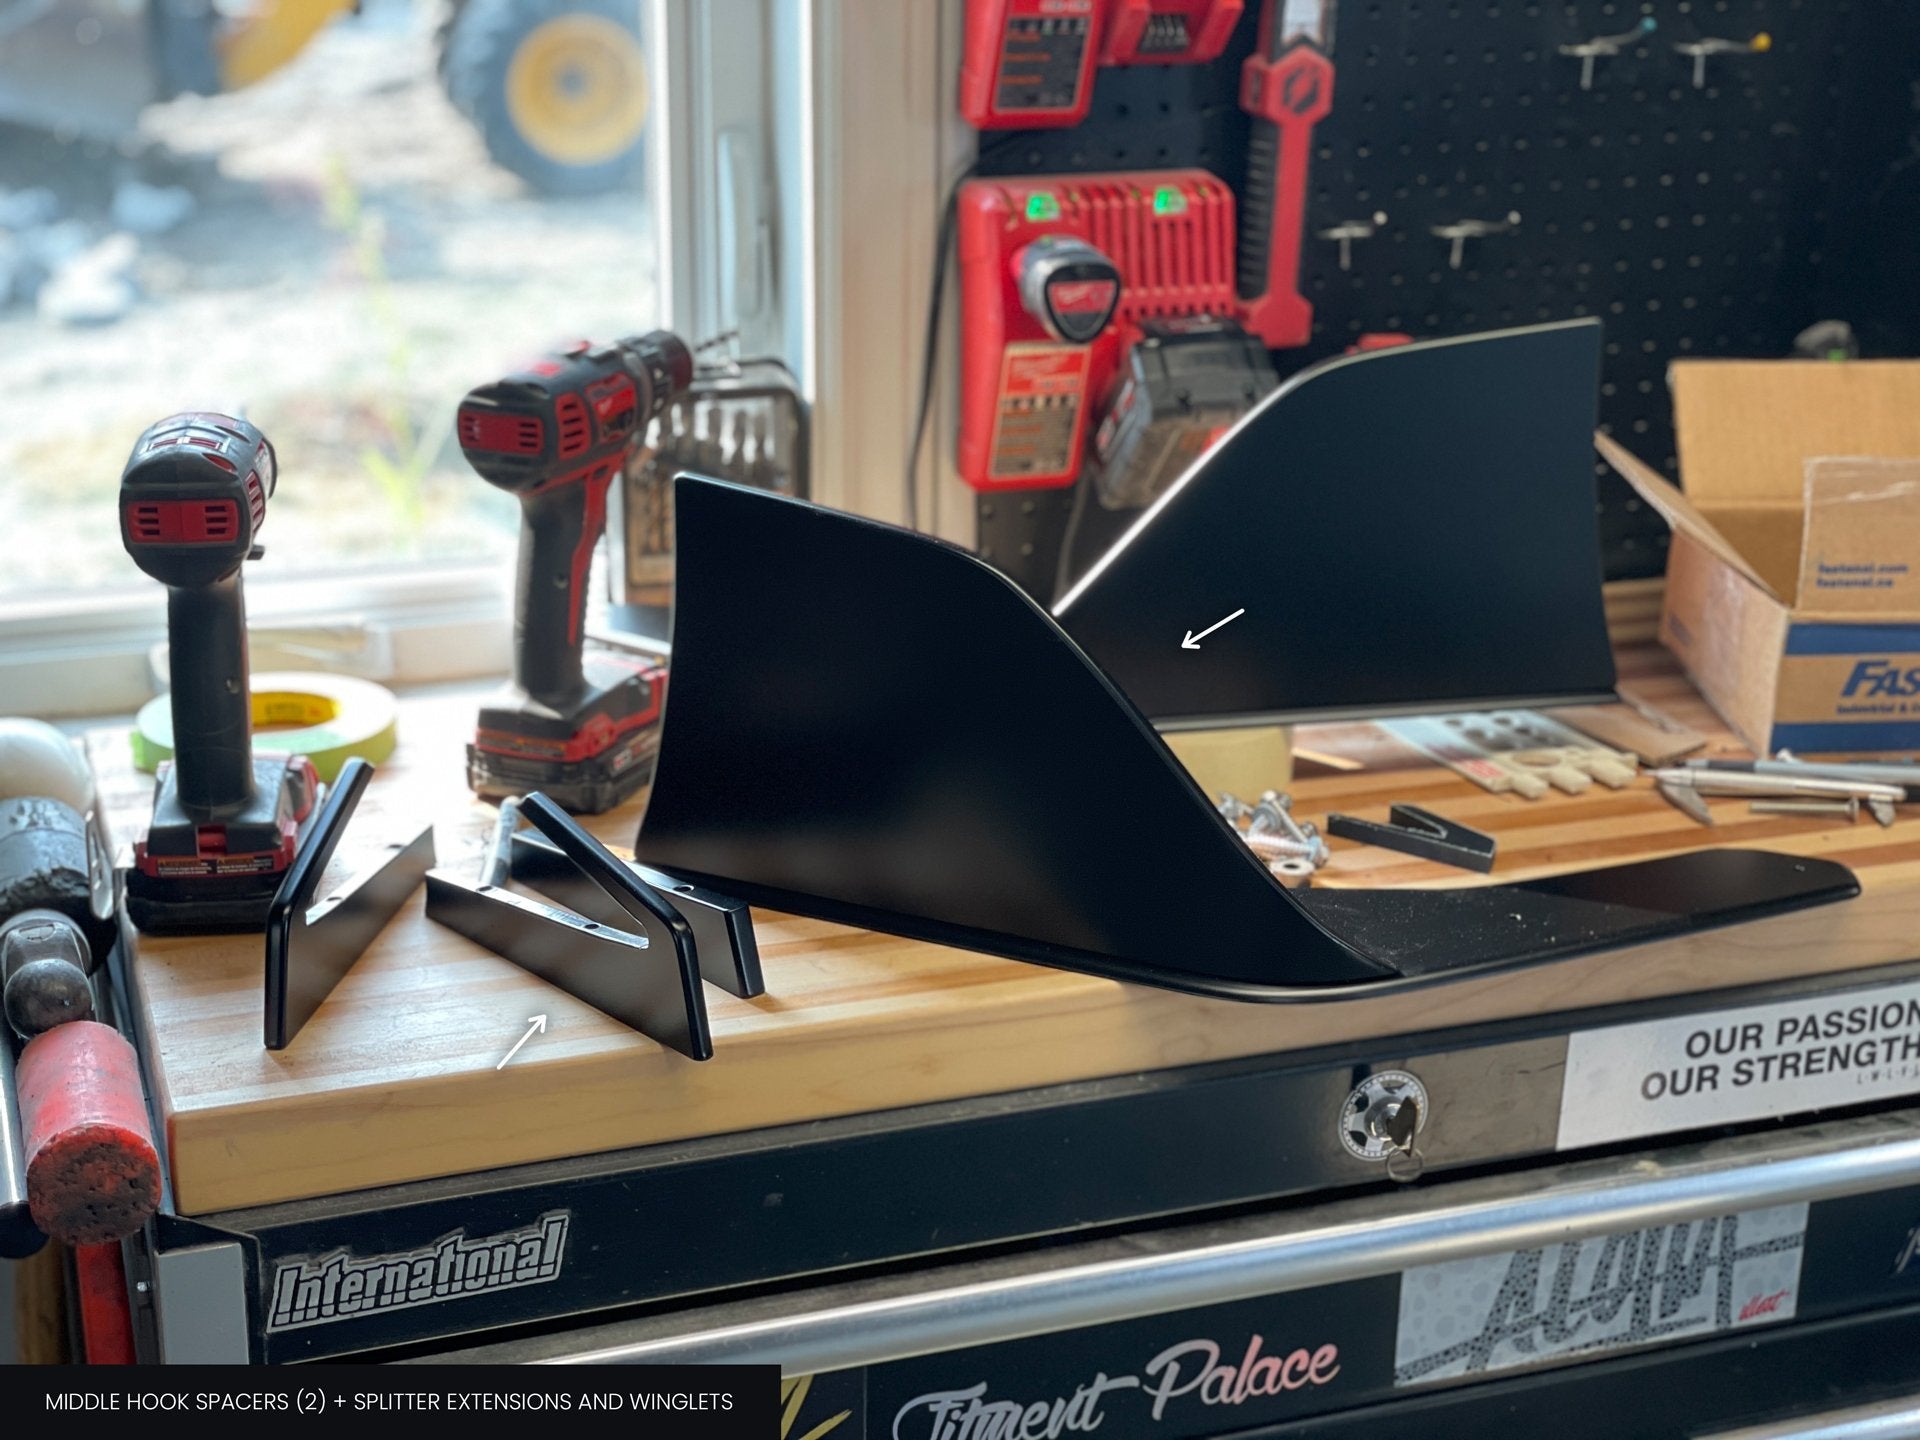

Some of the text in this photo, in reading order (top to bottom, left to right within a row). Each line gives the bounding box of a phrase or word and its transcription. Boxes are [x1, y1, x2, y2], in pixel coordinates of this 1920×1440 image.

[1641, 1064, 1720, 1101] OUR
[1732, 1033, 1920, 1087] STRENGTH
[1685, 998, 1920, 1060] OUR PASSION
[268, 1213, 569, 1332] International
[1143, 1334, 1341, 1421] Palace
